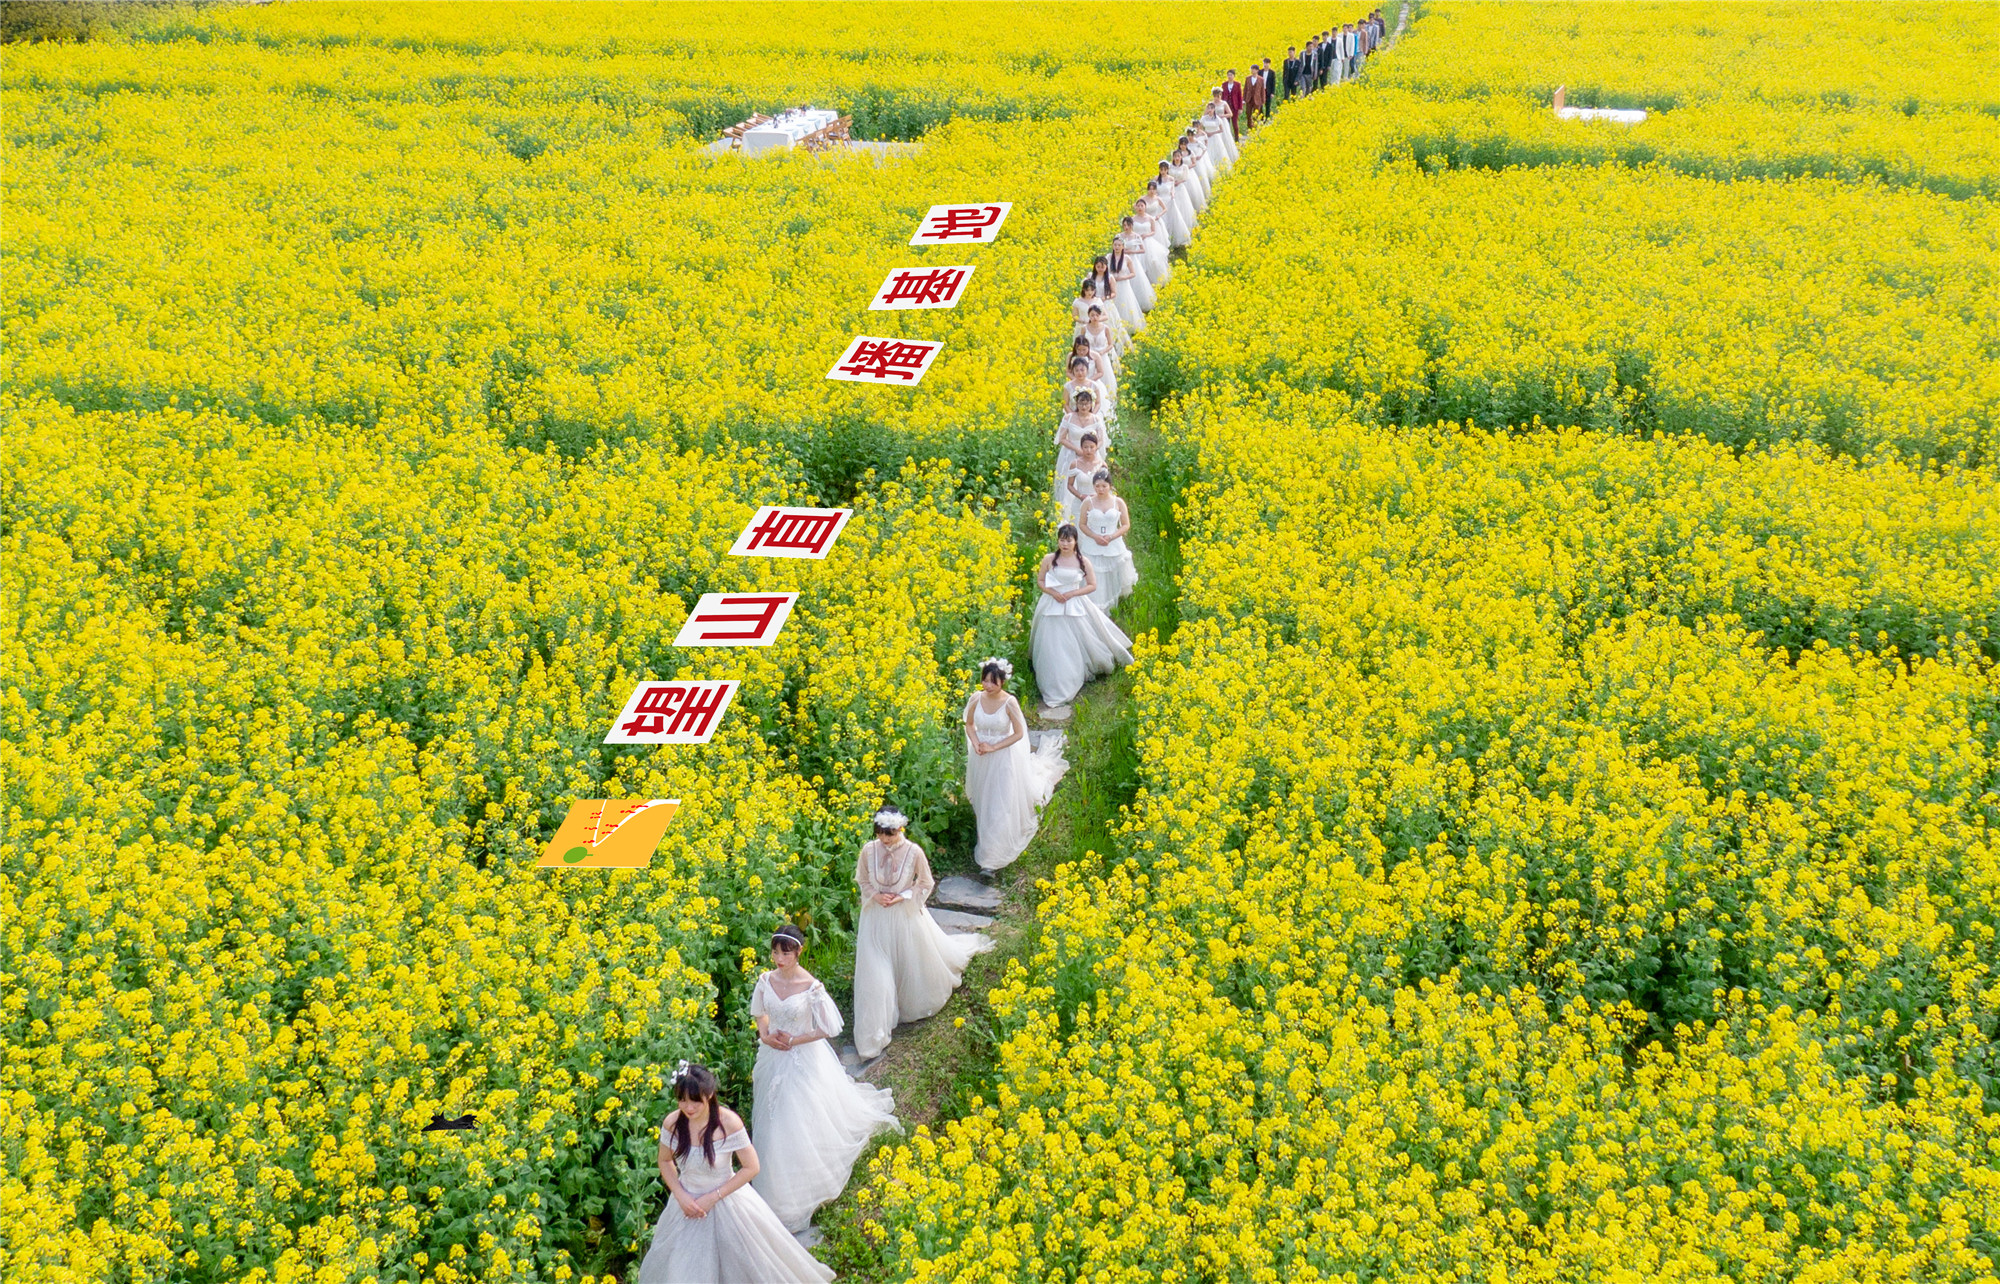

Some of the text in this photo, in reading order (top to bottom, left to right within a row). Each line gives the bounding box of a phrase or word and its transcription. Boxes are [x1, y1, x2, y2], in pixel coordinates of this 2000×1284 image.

[922, 206, 1002, 239] 地
[882, 269, 966, 303] 基
[838, 341, 934, 379] 播
[746, 511, 842, 553] 直
[695, 597, 789, 639] 山
[622, 685, 729, 736] 望
